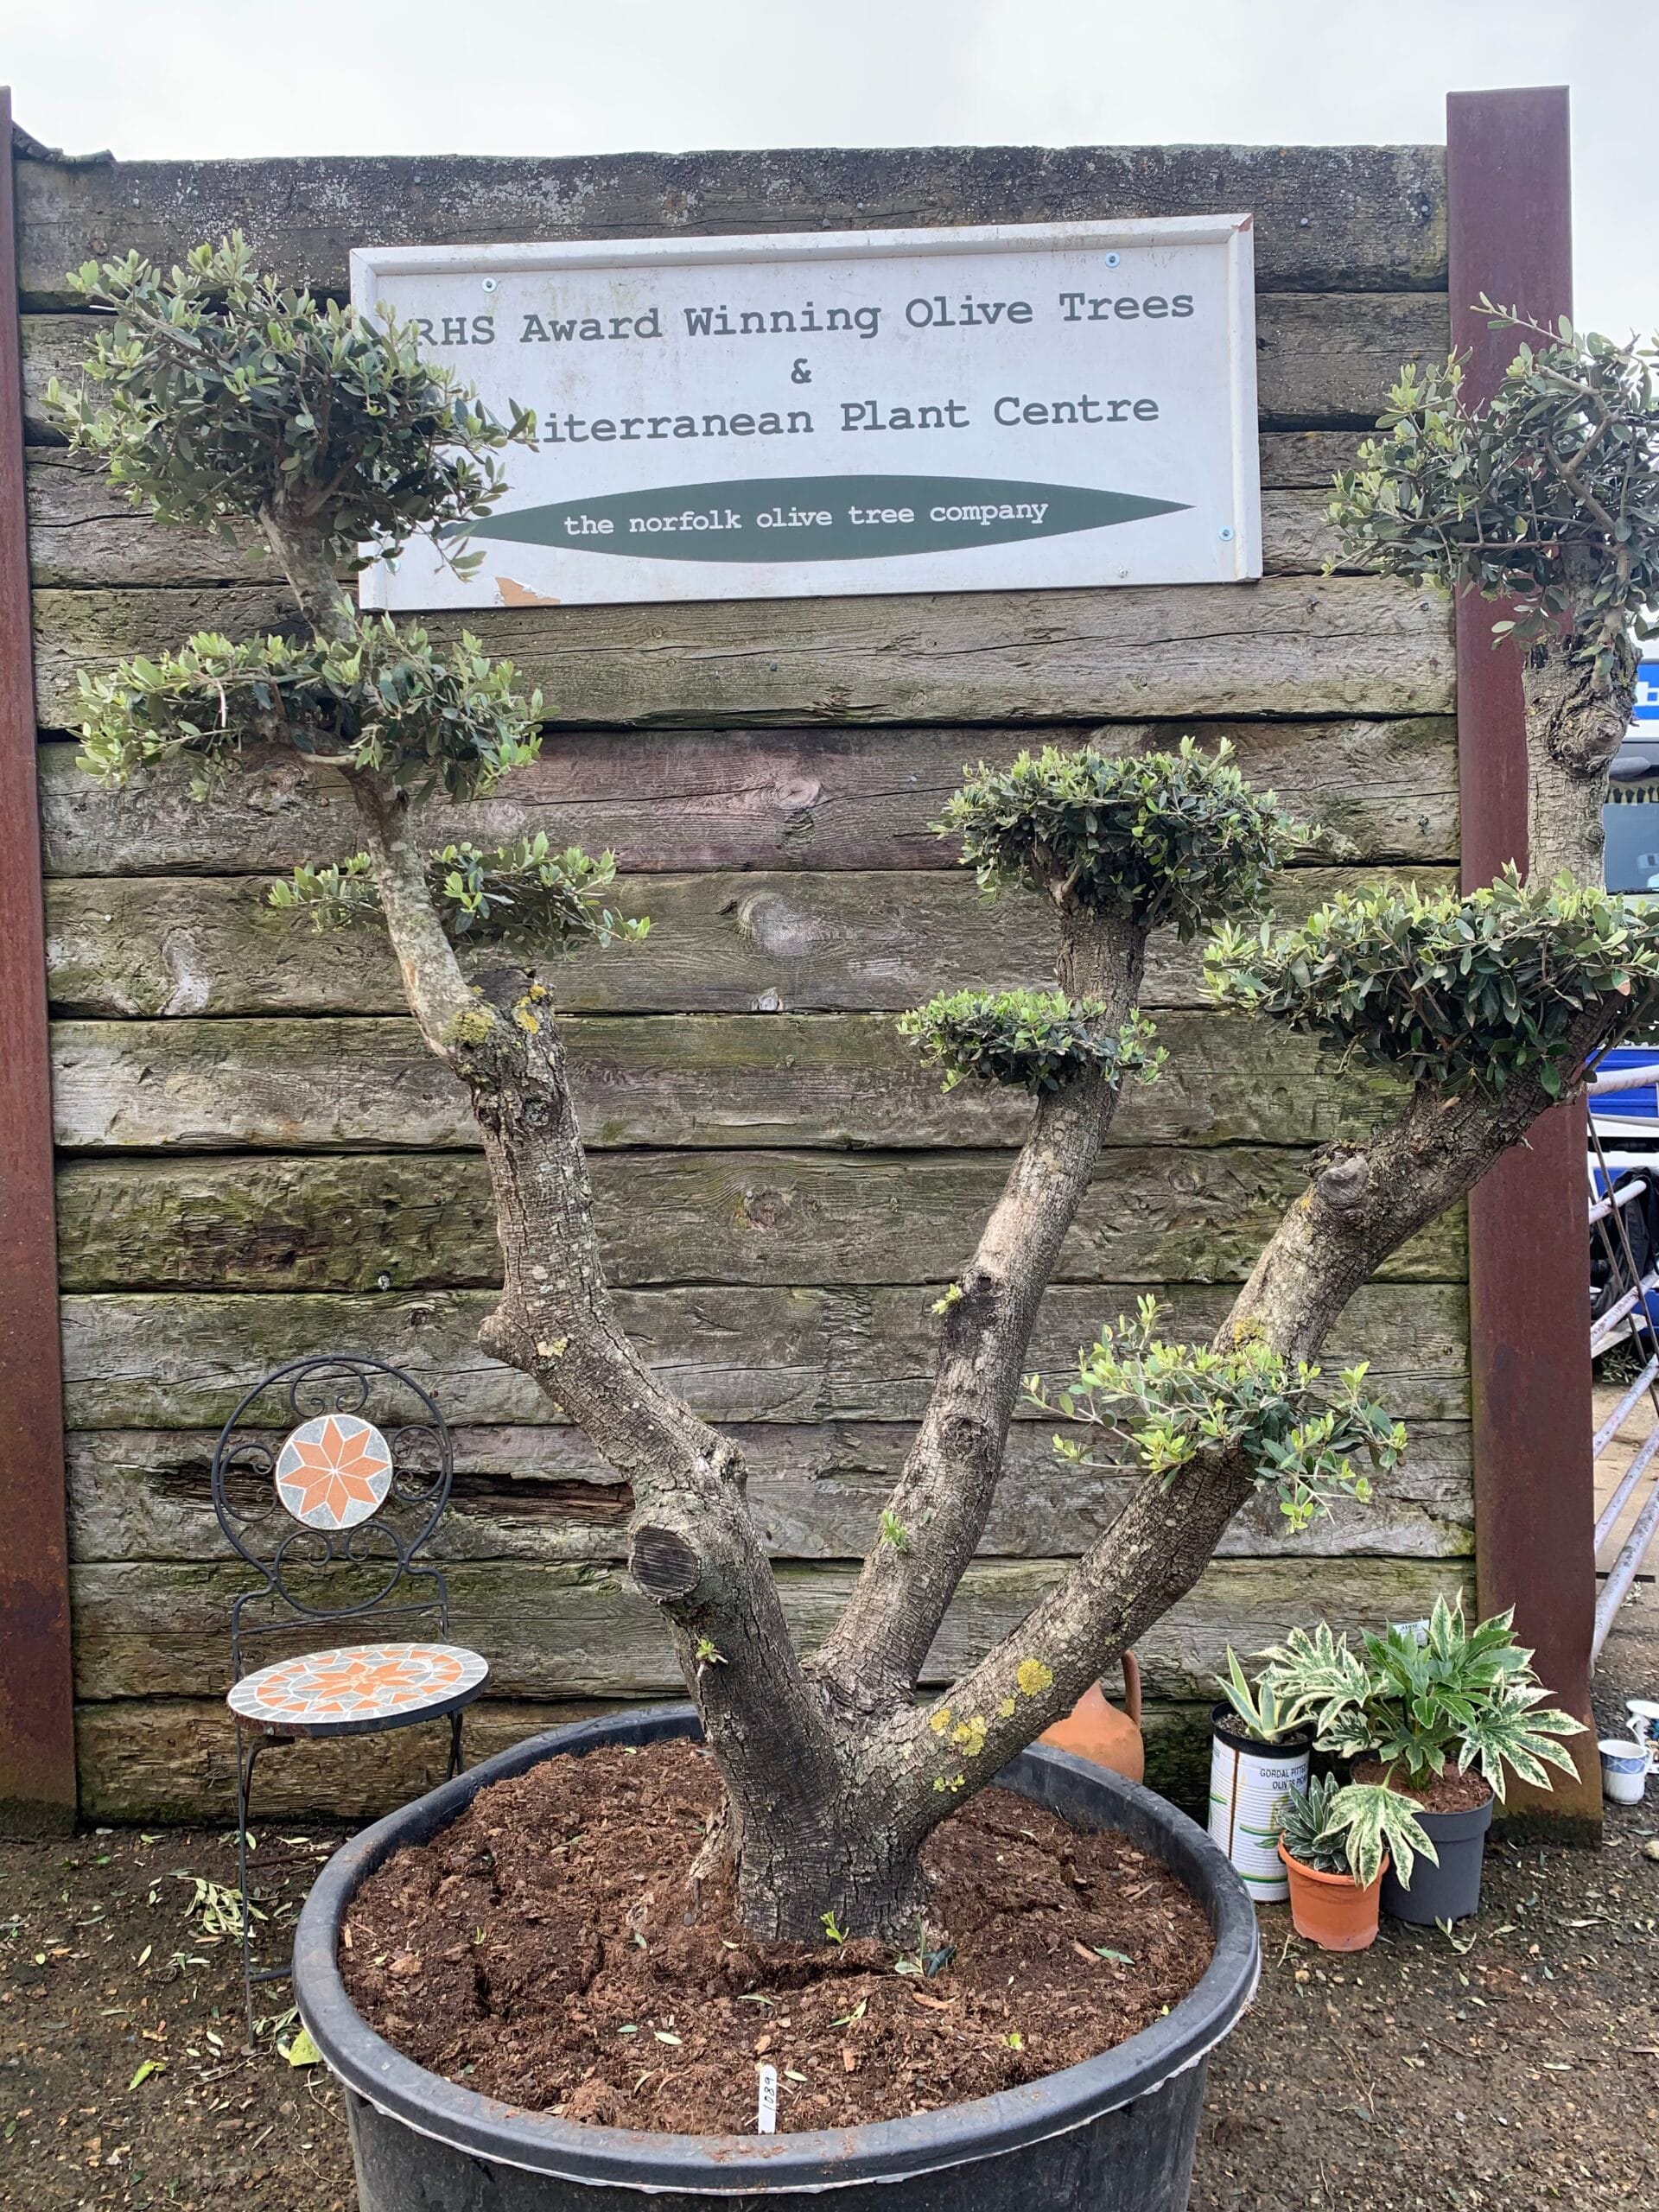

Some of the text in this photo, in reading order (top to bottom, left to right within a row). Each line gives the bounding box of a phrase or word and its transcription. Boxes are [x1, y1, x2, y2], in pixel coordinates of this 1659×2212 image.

[409, 292, 1194, 346] RHS Award Winning Olive Trees
[791, 359, 812, 385] &
[531, 395, 1159, 442] iterranean Plant Centre
[564, 503, 1049, 536] the norfolk olive tree company
[1260, 1769, 1290, 1778] GORDAL
[762, 2076, 776, 2112] 1089
